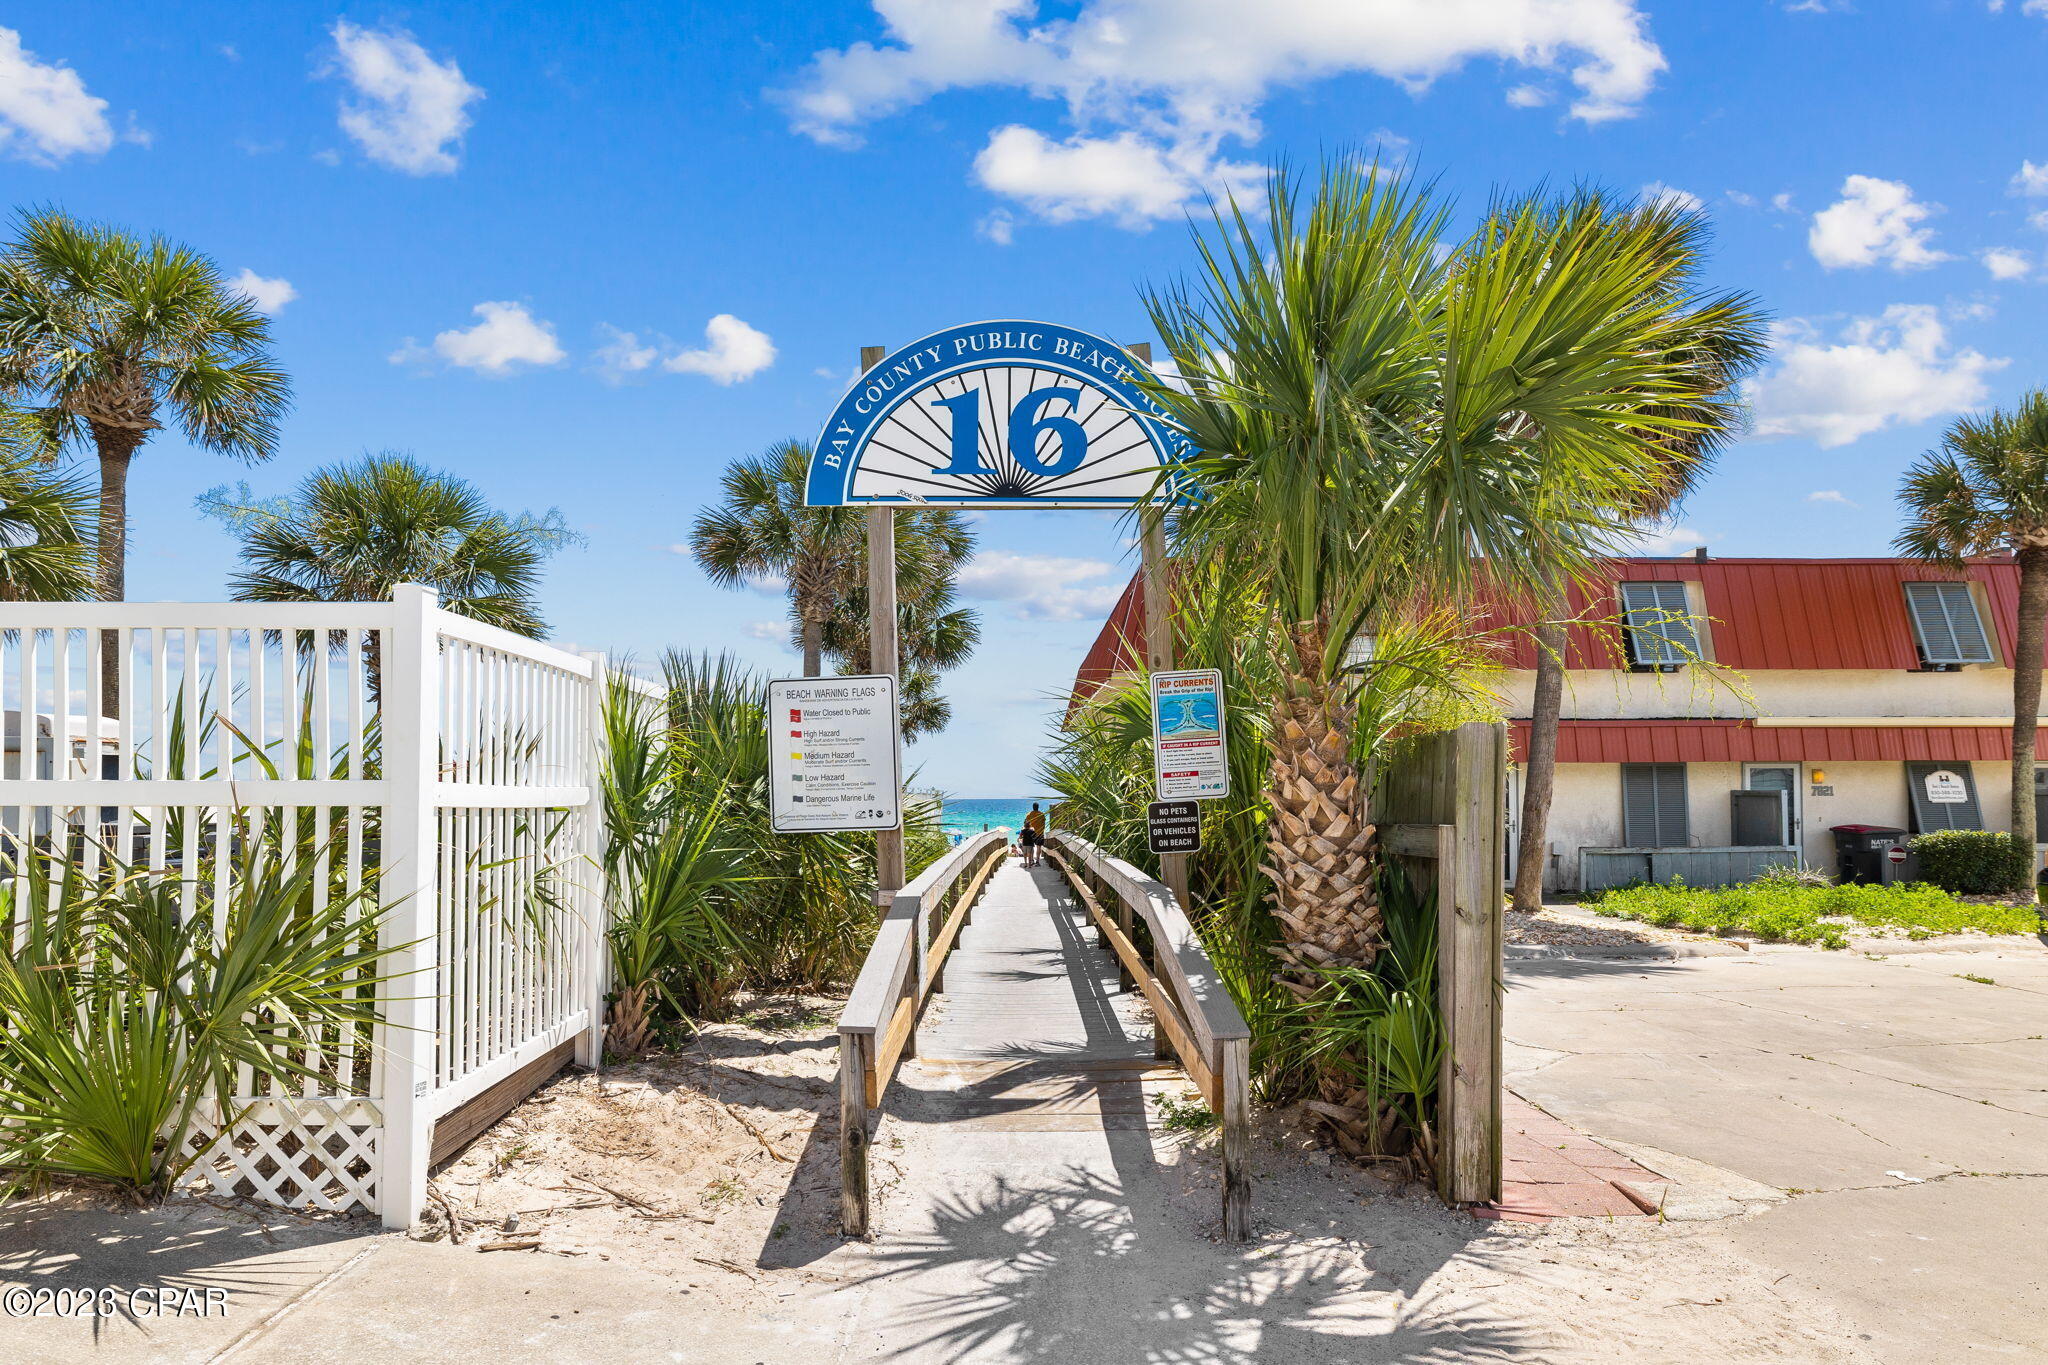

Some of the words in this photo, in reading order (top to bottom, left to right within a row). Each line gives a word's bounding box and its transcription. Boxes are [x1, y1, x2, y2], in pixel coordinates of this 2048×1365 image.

[824, 418, 856, 471] BAY
[855, 344, 942, 414] COUNTY
[953, 331, 1044, 356] PUBLIC
[1053, 336, 1136, 386] BEACH
[931, 386, 1088, 477] 16
[1159, 680, 1172, 689] RIP
[1173, 678, 1214, 688] CURRENTS
[786, 689, 811, 700] BEACH
[814, 687, 849, 698] WARNING
[852, 687, 876, 697] FLAGS
[803, 709, 822, 717] Water
[822, 708, 844, 717] Closed
[844, 708, 851, 716] to
[852, 707, 871, 716] Public
[803, 730, 818, 740] High
[818, 729, 840, 737] Hazard
[804, 751, 830, 760] Medium
[831, 750, 855, 759] Hazard
[804, 774, 819, 782] Low
[820, 773, 845, 781] Hazard
[805, 795, 840, 804] Dangerous
[840, 794, 862, 802] Marine
[863, 793, 876, 801] Life
[1159, 808, 1169, 816] NO
[1170, 807, 1188, 815] PETS
[1167, 816, 1198, 824] CONTAINERS
[1153, 828, 1163, 836] OR
[1164, 826, 1197, 835] VEHICLES
[1158, 839, 1169, 847] ON
[1170, 838, 1192, 846] BEACH
